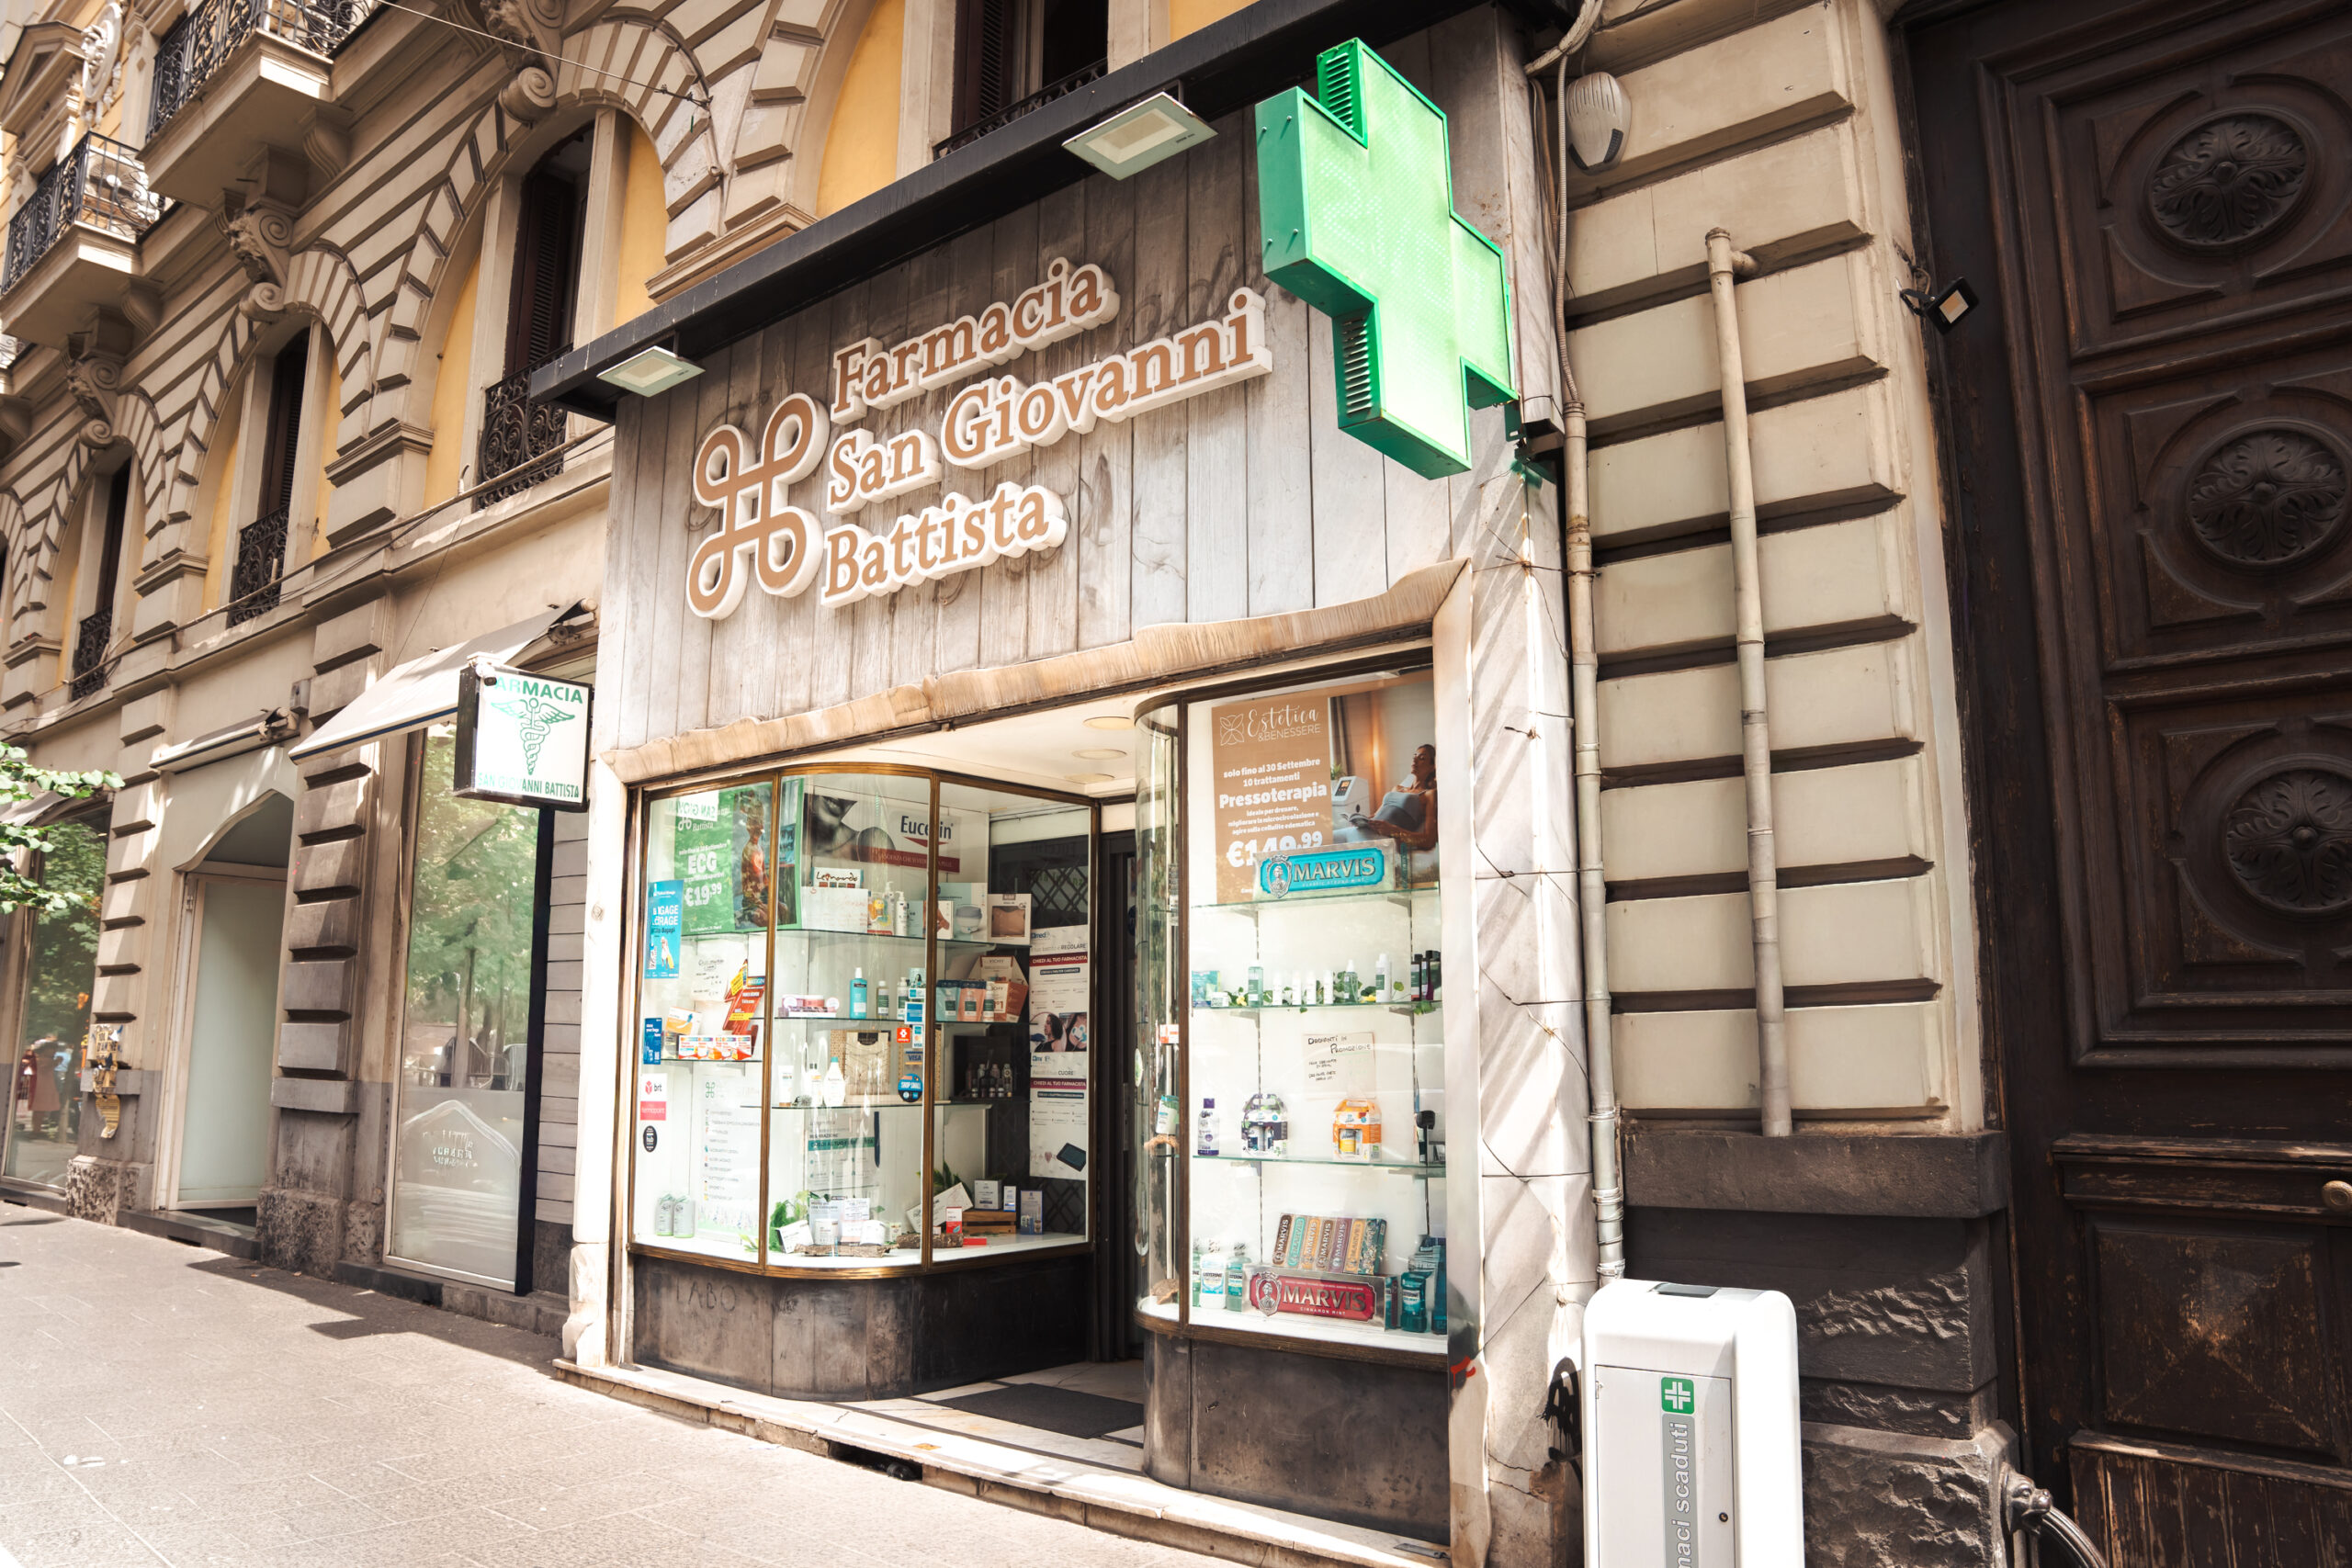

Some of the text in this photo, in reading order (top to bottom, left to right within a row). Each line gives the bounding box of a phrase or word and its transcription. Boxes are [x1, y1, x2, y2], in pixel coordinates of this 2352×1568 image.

[833, 261, 1103, 413] Farmacia
[830, 293, 1255, 506] San Giovanni
[824, 487, 1048, 598] Battista
[492, 676, 583, 705] ARMACIA
[1248, 705, 1320, 738] Estetica
[1223, 758, 1320, 778] solo fino al 30 Settembre
[1243, 772, 1300, 787] 10 trattamenti
[478, 773, 580, 798] SAN GIOVANNI BATTISTA
[1219, 781, 1328, 808] Pressoterapia
[688, 852, 718, 874] ECG
[1294, 857, 1375, 883] MARVIS
[653, 1084, 662, 1092] brt
[1279, 1219, 1289, 1252] MARVIS
[1306, 1222, 1317, 1255] MARVIS
[1321, 1223, 1331, 1257] MARVIS
[1336, 1224, 1346, 1258] MARVIS
[1283, 1284, 1367, 1312] MARVIS
[1300, 1306, 1329, 1314] CINNAMON
[1668, 1422, 1690, 1514] scaduti
